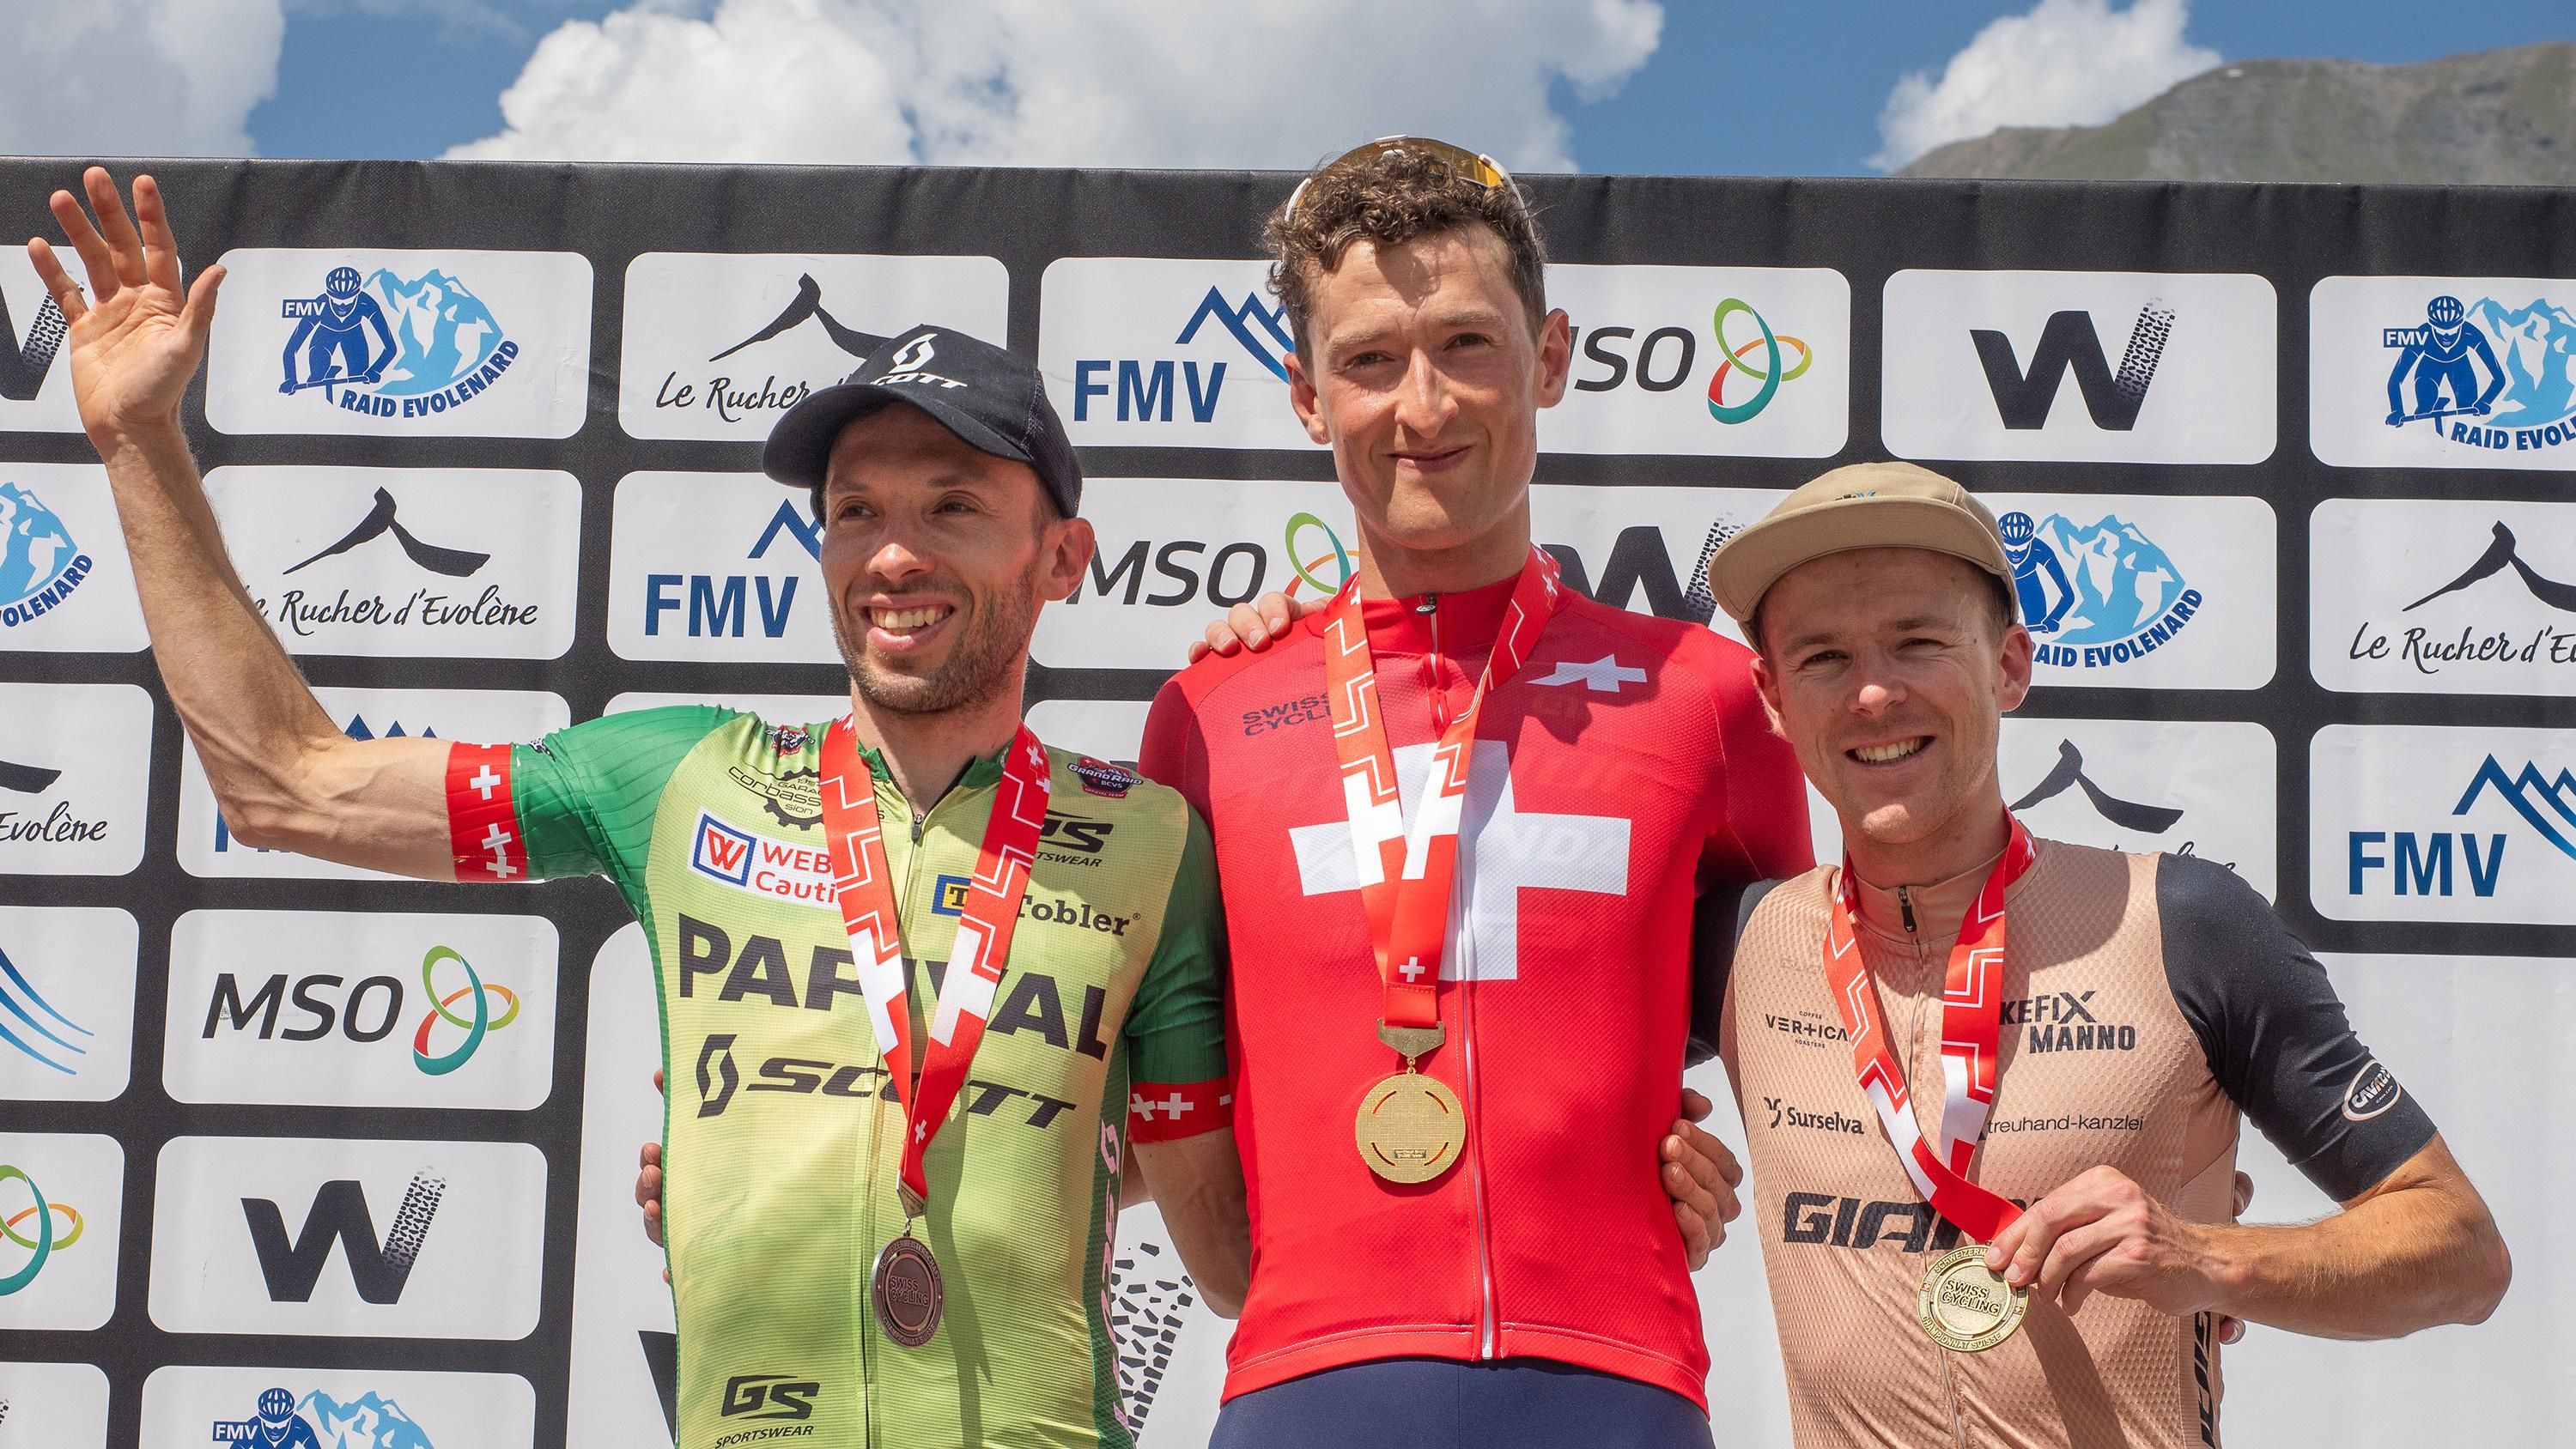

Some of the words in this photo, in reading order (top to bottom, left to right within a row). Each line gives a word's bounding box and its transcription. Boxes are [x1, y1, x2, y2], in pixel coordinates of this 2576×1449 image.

[285, 301, 325, 316] FMV
[2385, 330, 2429, 346] FMV
[1569, 326, 1696, 392] SO
[340, 389, 397, 418] RAID
[403, 340, 519, 419] EVOLENARD
[869, 372, 969, 389] COTT
[1073, 359, 1227, 423] FMV
[656, 371, 696, 408] Le
[706, 375, 811, 423] Rucher
[2451, 421, 2510, 450] RAID
[1066, 540, 1267, 609] MSO
[0, 555, 93, 627] OLENARD
[279, 589, 392, 636] Rucher
[393, 584, 538, 626] d'Evolène
[645, 573, 799, 639] FMV
[2032, 641, 2077, 668] AID
[2084, 589, 2202, 668] EVOLENARD
[2349, 621, 2391, 660] Le
[2402, 626, 2518, 675] Rucher
[1036, 851, 1103, 868] TSWEAR
[2348, 830, 2507, 898] FMV
[202, 973, 404, 1043] MSO
[1799, 1010, 1823, 1020] COFFEE
[1795, 1039, 1826, 1049] ROASTERS
[2029, 1024, 2136, 1054] MANNO
[1787, 1106, 1865, 1135] Surselva
[1987, 1114, 2144, 1134] treuhand-kanzlei
[890, 1275, 919, 1291] SWISS
[890, 1288, 929, 1307] CYCLING
[1945, 1279, 1990, 1299] SWISS
[1941, 1290, 2001, 1317] CYCLING
[1922, 1316, 1969, 1349] CHAMPIONNAT
[1971, 1332, 2002, 1349] SUISSE
[721, 1374, 821, 1420] GS
[216, 1424, 258, 1441] FMV
[714, 1425, 814, 1449] SPORTSWEAR
